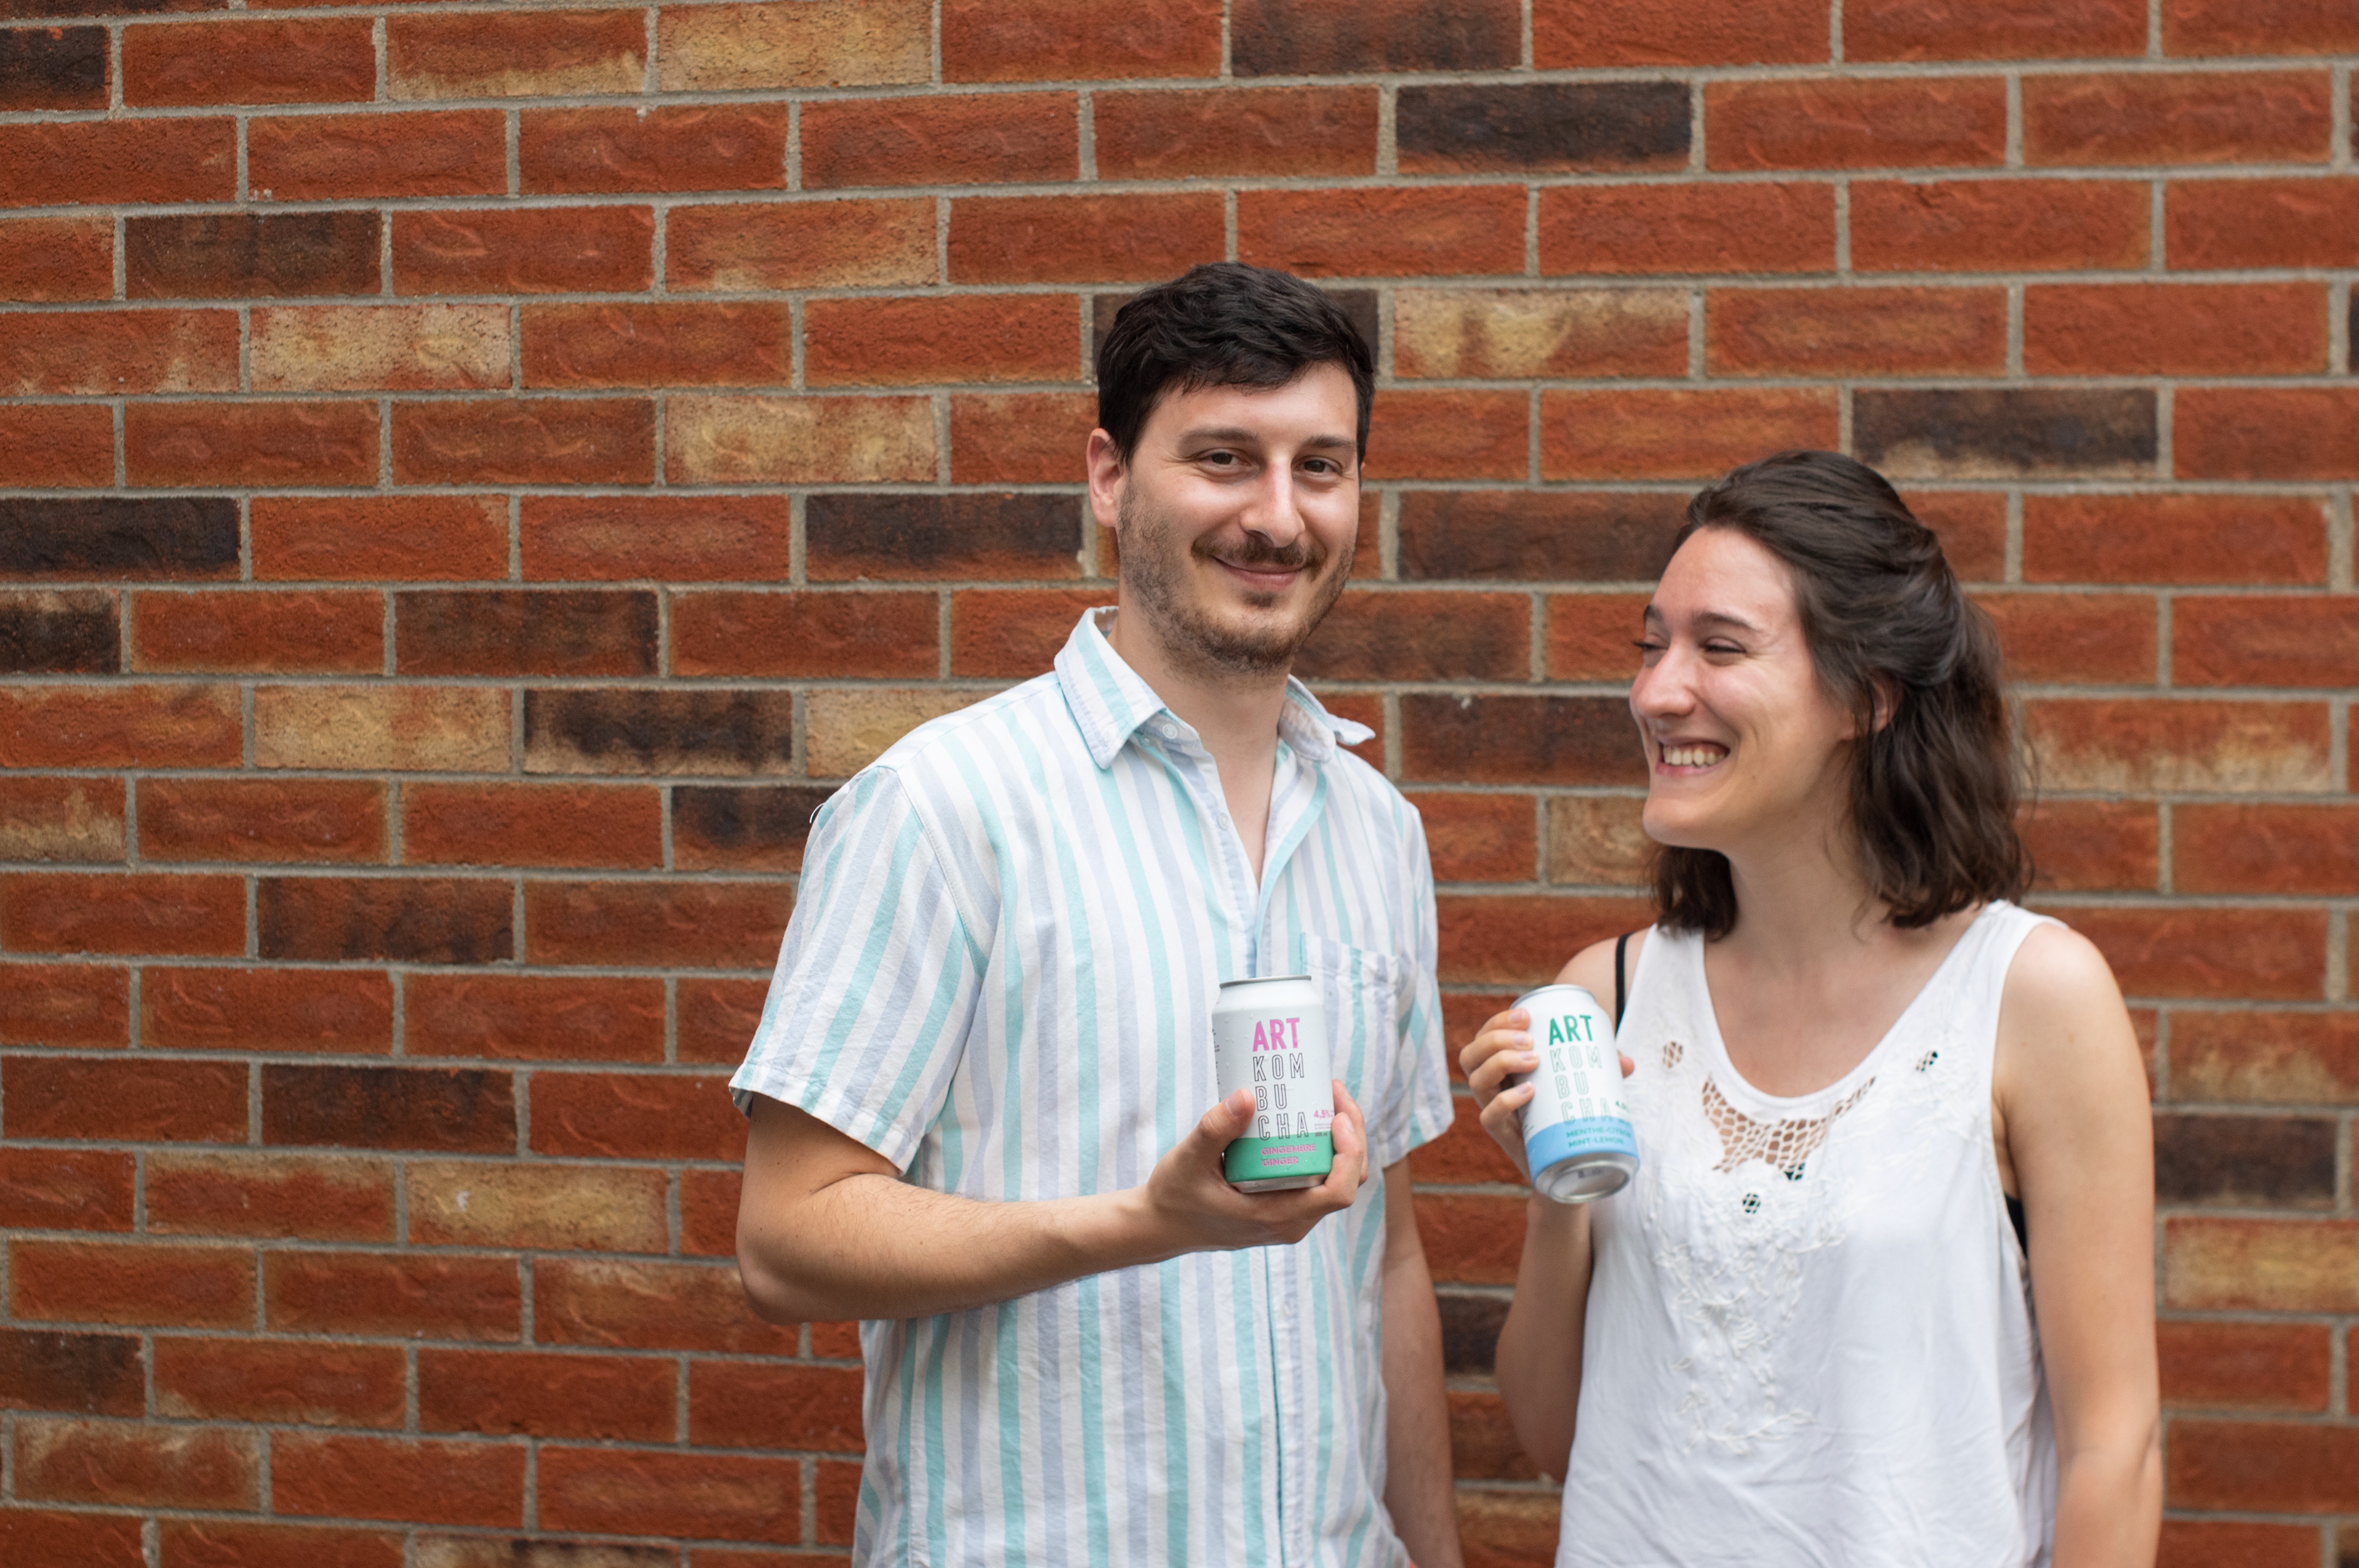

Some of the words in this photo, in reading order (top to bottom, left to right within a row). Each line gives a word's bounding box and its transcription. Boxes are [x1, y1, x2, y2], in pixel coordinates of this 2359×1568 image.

[1253, 1017, 1300, 1052] ART
[1549, 1014, 1593, 1046] ART
[1253, 1052, 1304, 1081] KOM
[1549, 1045, 1603, 1073] KOM
[1255, 1084, 1287, 1111] BU
[1554, 1071, 1589, 1099] BU
[1561, 1097, 1614, 1125] CHA
[1258, 1112, 1309, 1140] CHA
[1261, 1143, 1316, 1156] GINGEMBRE
[1262, 1157, 1298, 1167] GINGER
